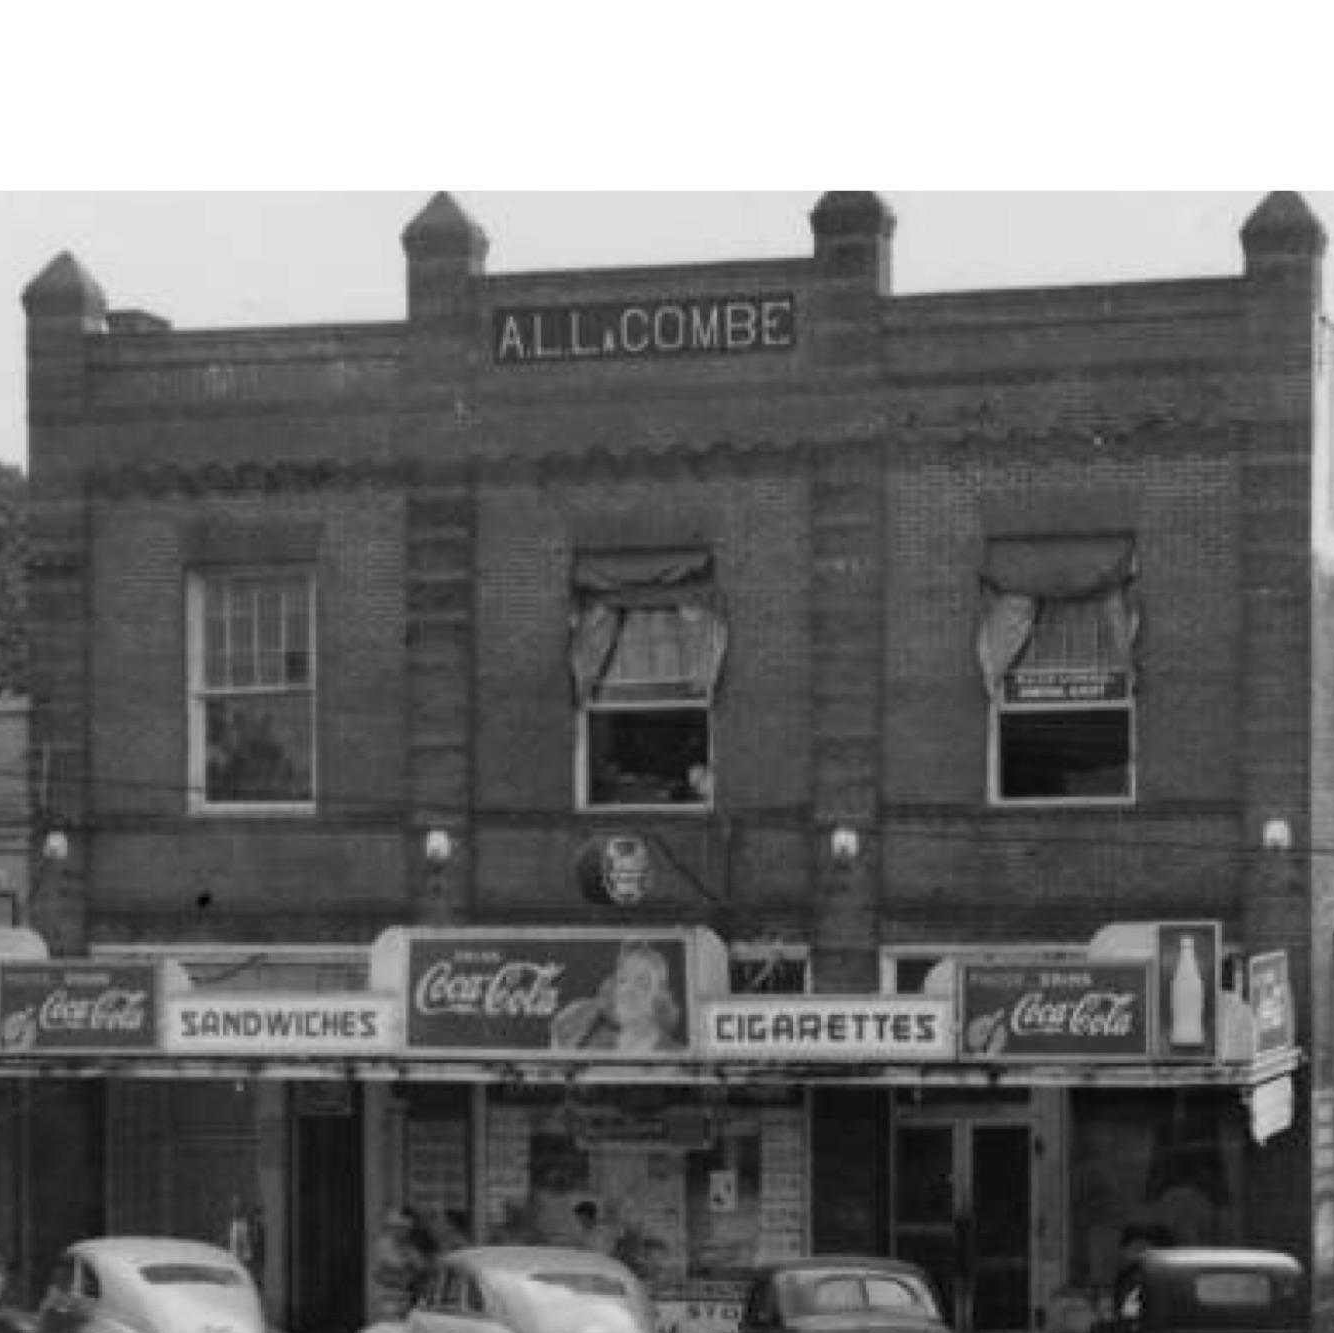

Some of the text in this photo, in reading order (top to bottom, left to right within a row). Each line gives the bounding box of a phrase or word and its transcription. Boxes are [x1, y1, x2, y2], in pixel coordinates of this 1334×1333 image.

[417, 961, 564, 1015] Coca-Cola
[40, 990, 147, 1031] Coca-Cola
[180, 1008, 378, 1037] SANDWICHES
[717, 1013, 936, 1041] CIGARETTES
[1011, 992, 1134, 1036] Coca-Cola
